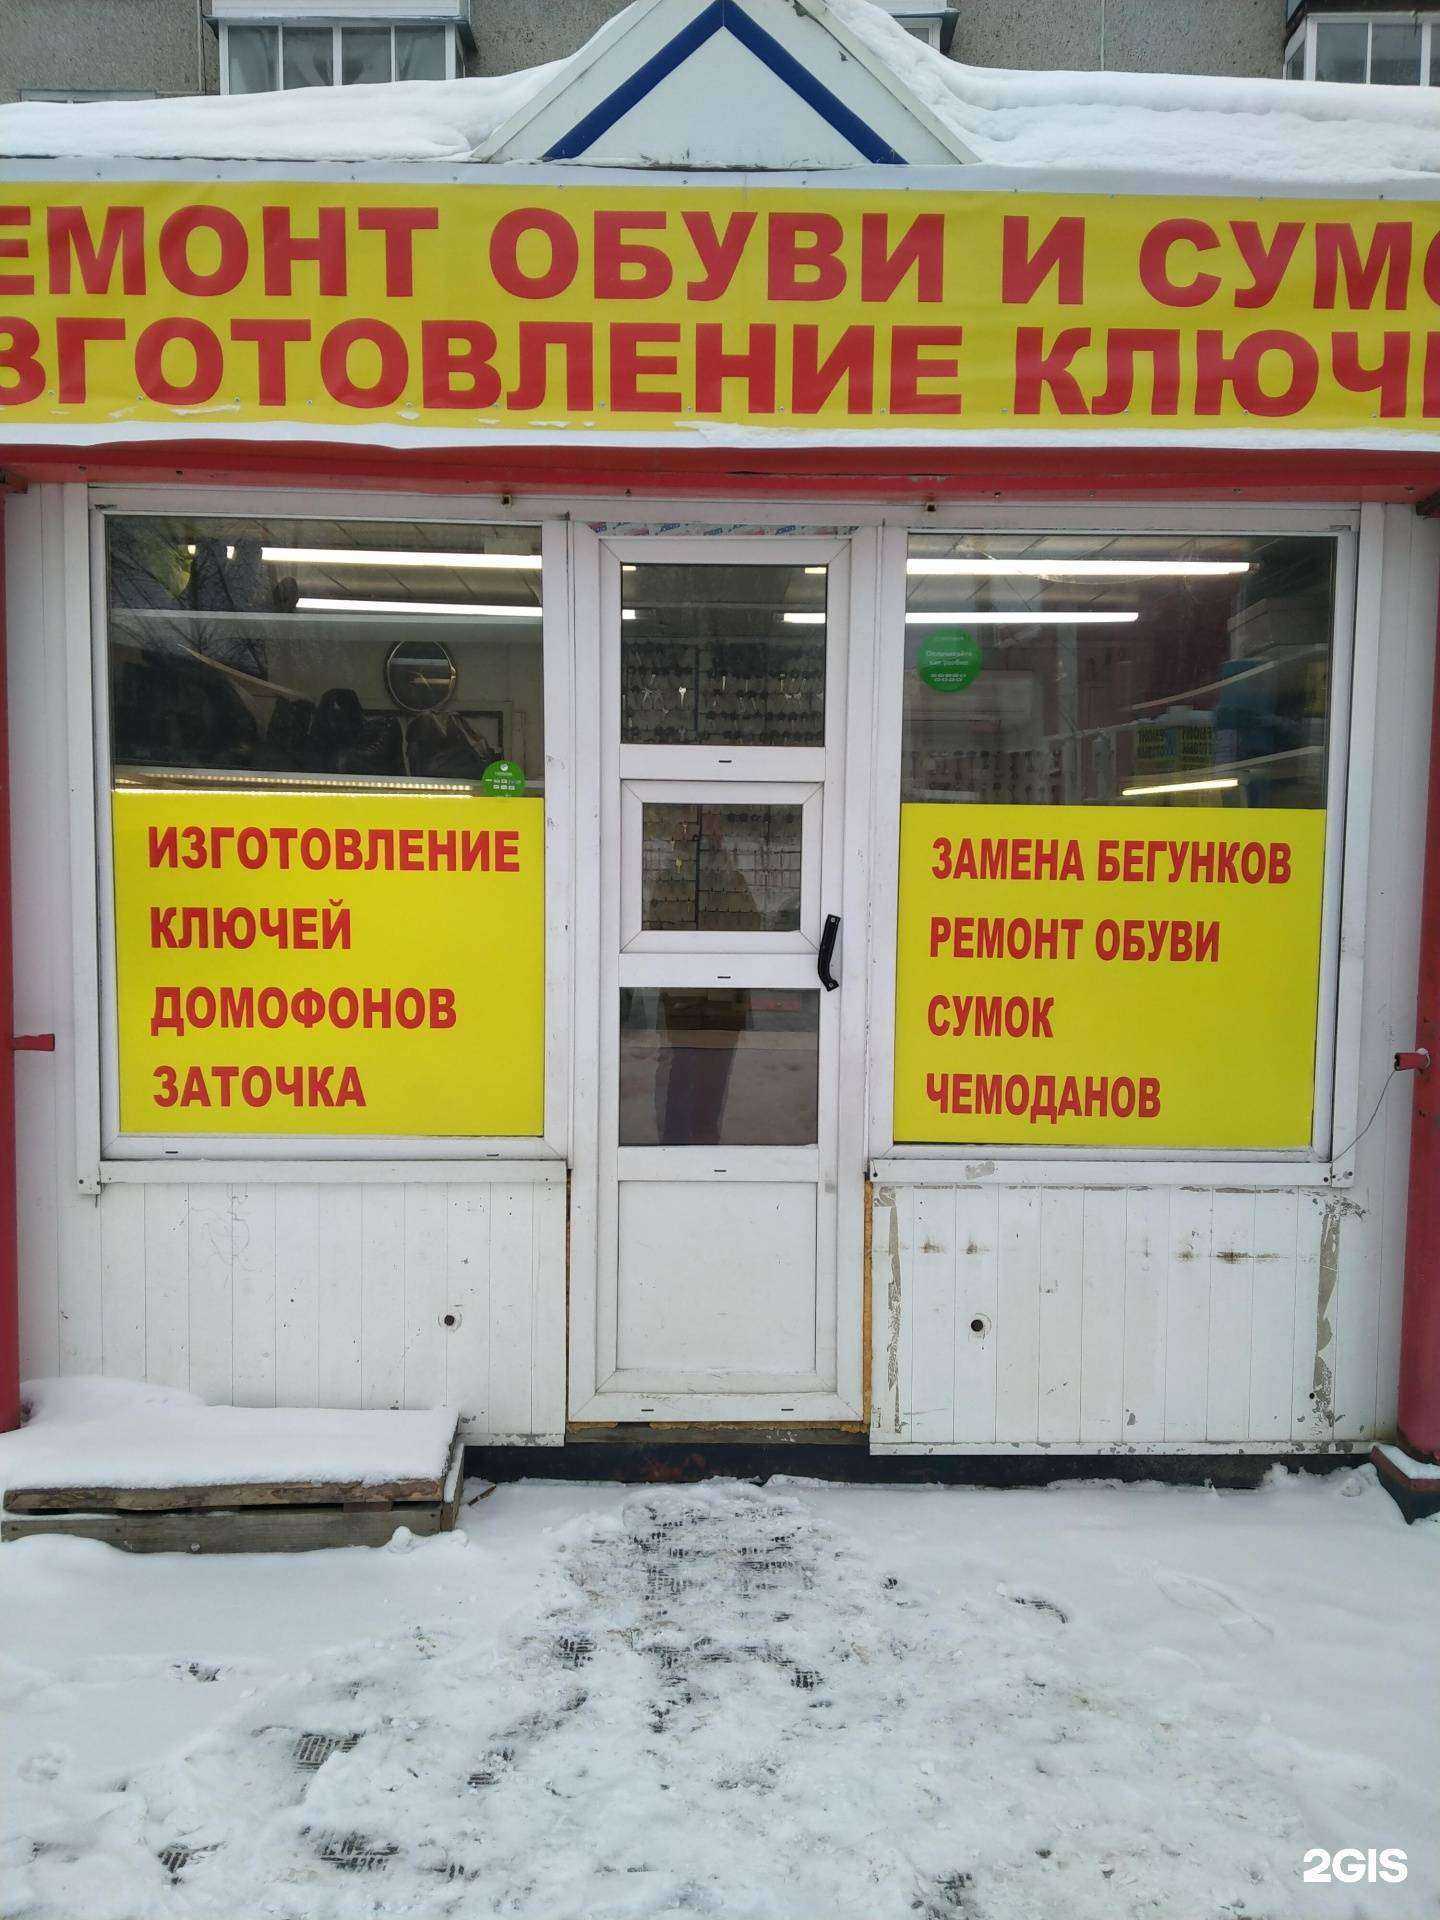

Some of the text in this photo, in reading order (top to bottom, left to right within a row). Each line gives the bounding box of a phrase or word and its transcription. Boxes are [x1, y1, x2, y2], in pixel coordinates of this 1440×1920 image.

[489, 207, 945, 303] ОБУВИ
[1002, 216, 1086, 306] И
[1139, 218, 1440, 311] СУМ
[1012, 327, 1440, 419] КЛЮЧ
[148, 825, 520, 873] ИЗГОТОВЛЕНИЕ
[931, 837, 1292, 884] ЗАМЕНА БЕГУНКОВ
[150, 898, 352, 950] КЛЮЧЕЙ
[929, 915, 1221, 963] РЕМОНТ ОБУВИ
[150, 986, 458, 1037] ДОМОФОНОВ
[927, 994, 1055, 1038] СУМОК
[152, 1065, 367, 1108] ЗАТОЧКА
[925, 1073, 1162, 1125] ЧЕМОДАНОВ
